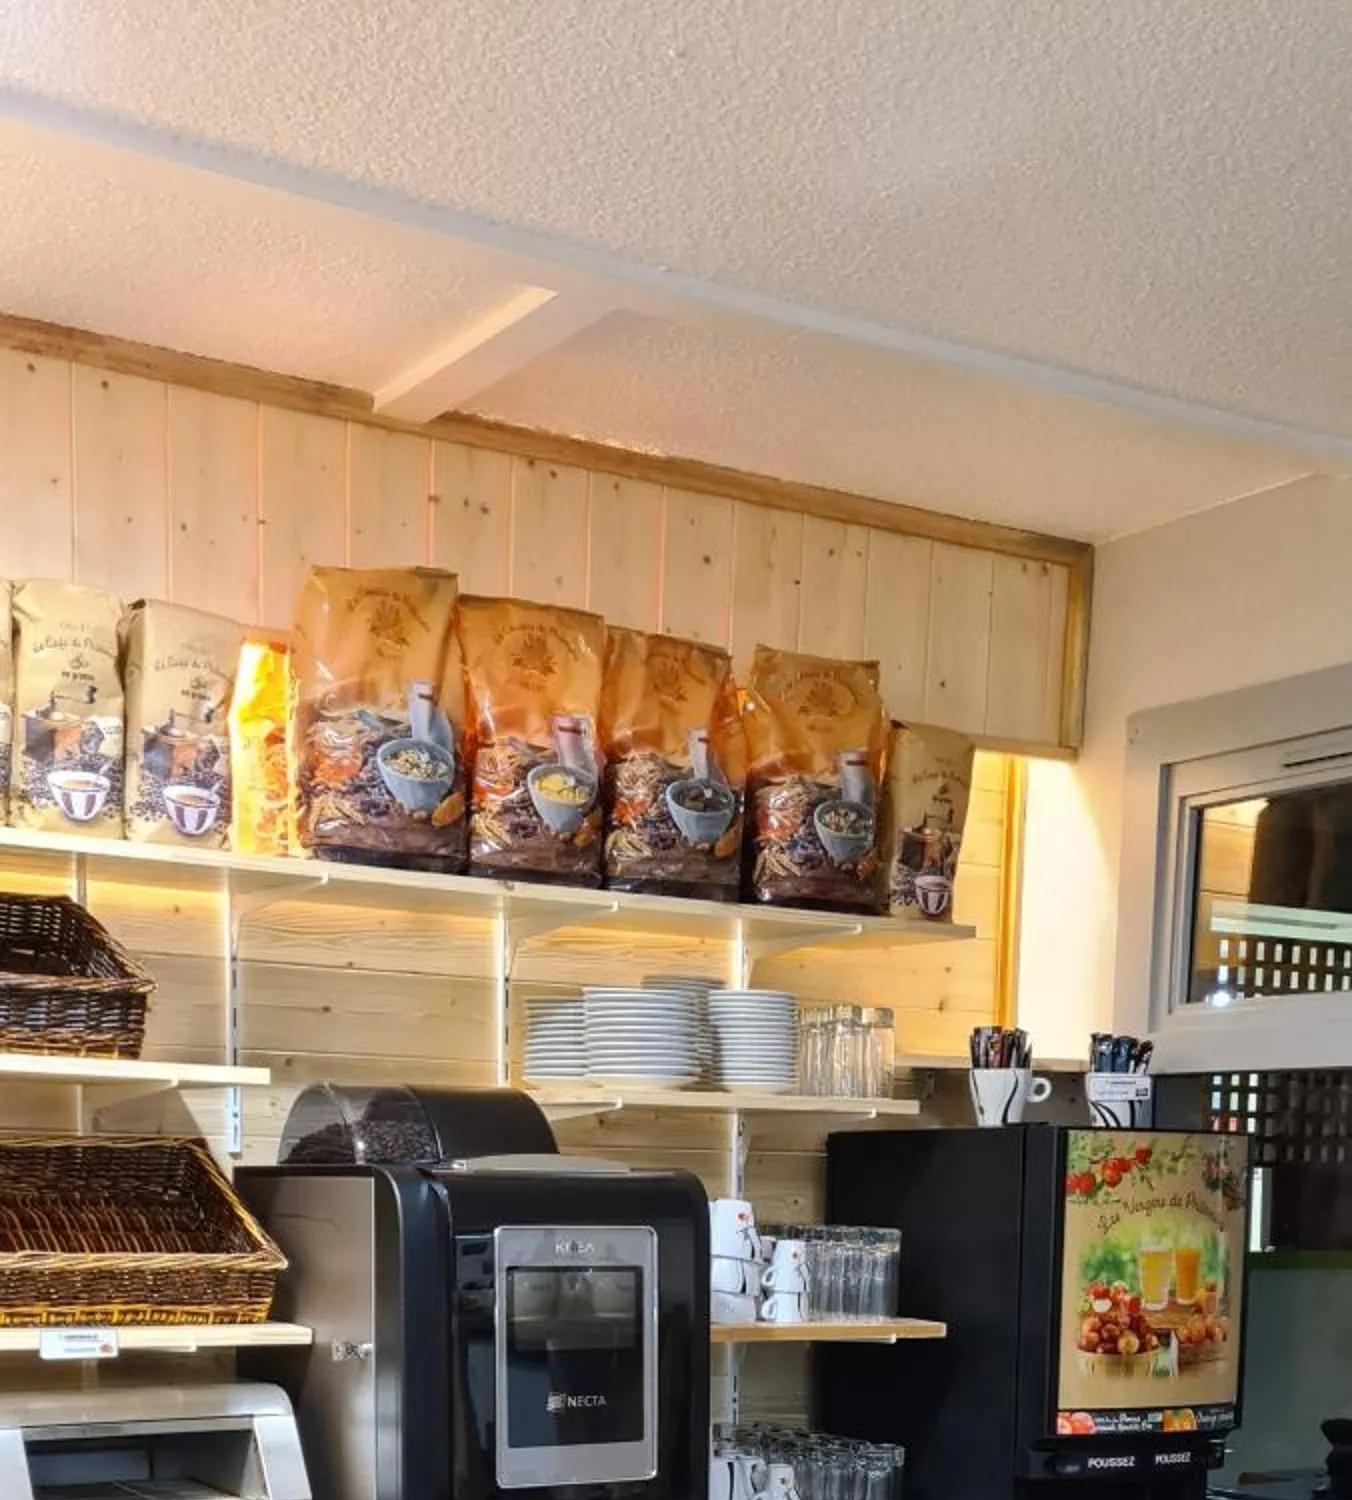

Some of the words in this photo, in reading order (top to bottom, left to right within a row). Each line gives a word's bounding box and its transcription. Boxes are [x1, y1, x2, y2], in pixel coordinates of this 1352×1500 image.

[567, 1395, 607, 1408] NECTA
[1088, 1455, 1136, 1470] POUSSEZ
[1155, 1452, 1192, 1465] POUSSEZ
